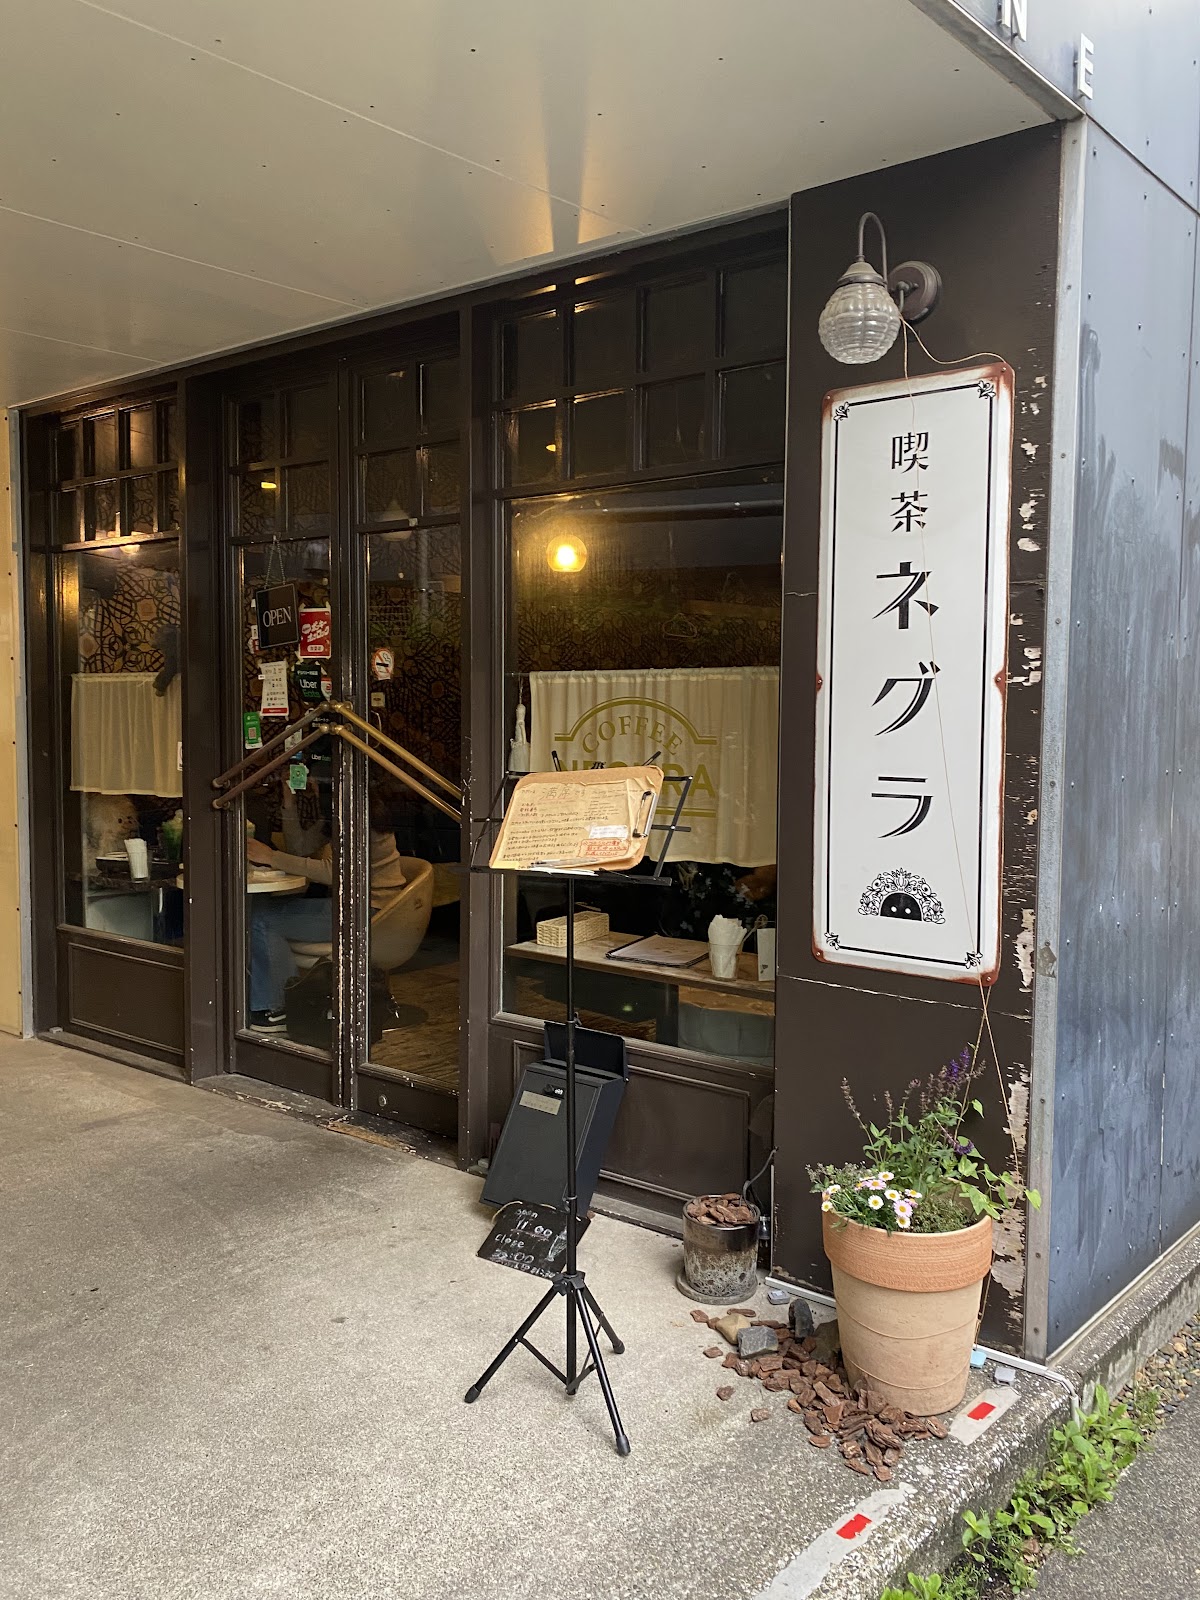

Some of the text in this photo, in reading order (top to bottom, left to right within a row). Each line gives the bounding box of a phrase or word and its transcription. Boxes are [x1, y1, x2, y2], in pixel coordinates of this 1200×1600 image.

[263, 606, 292, 628] OPEN
[871, 431, 942, 839] 喫茶ネグラ
[300, 679, 317, 689] Uber
[582, 715, 683, 755] COFFEE
